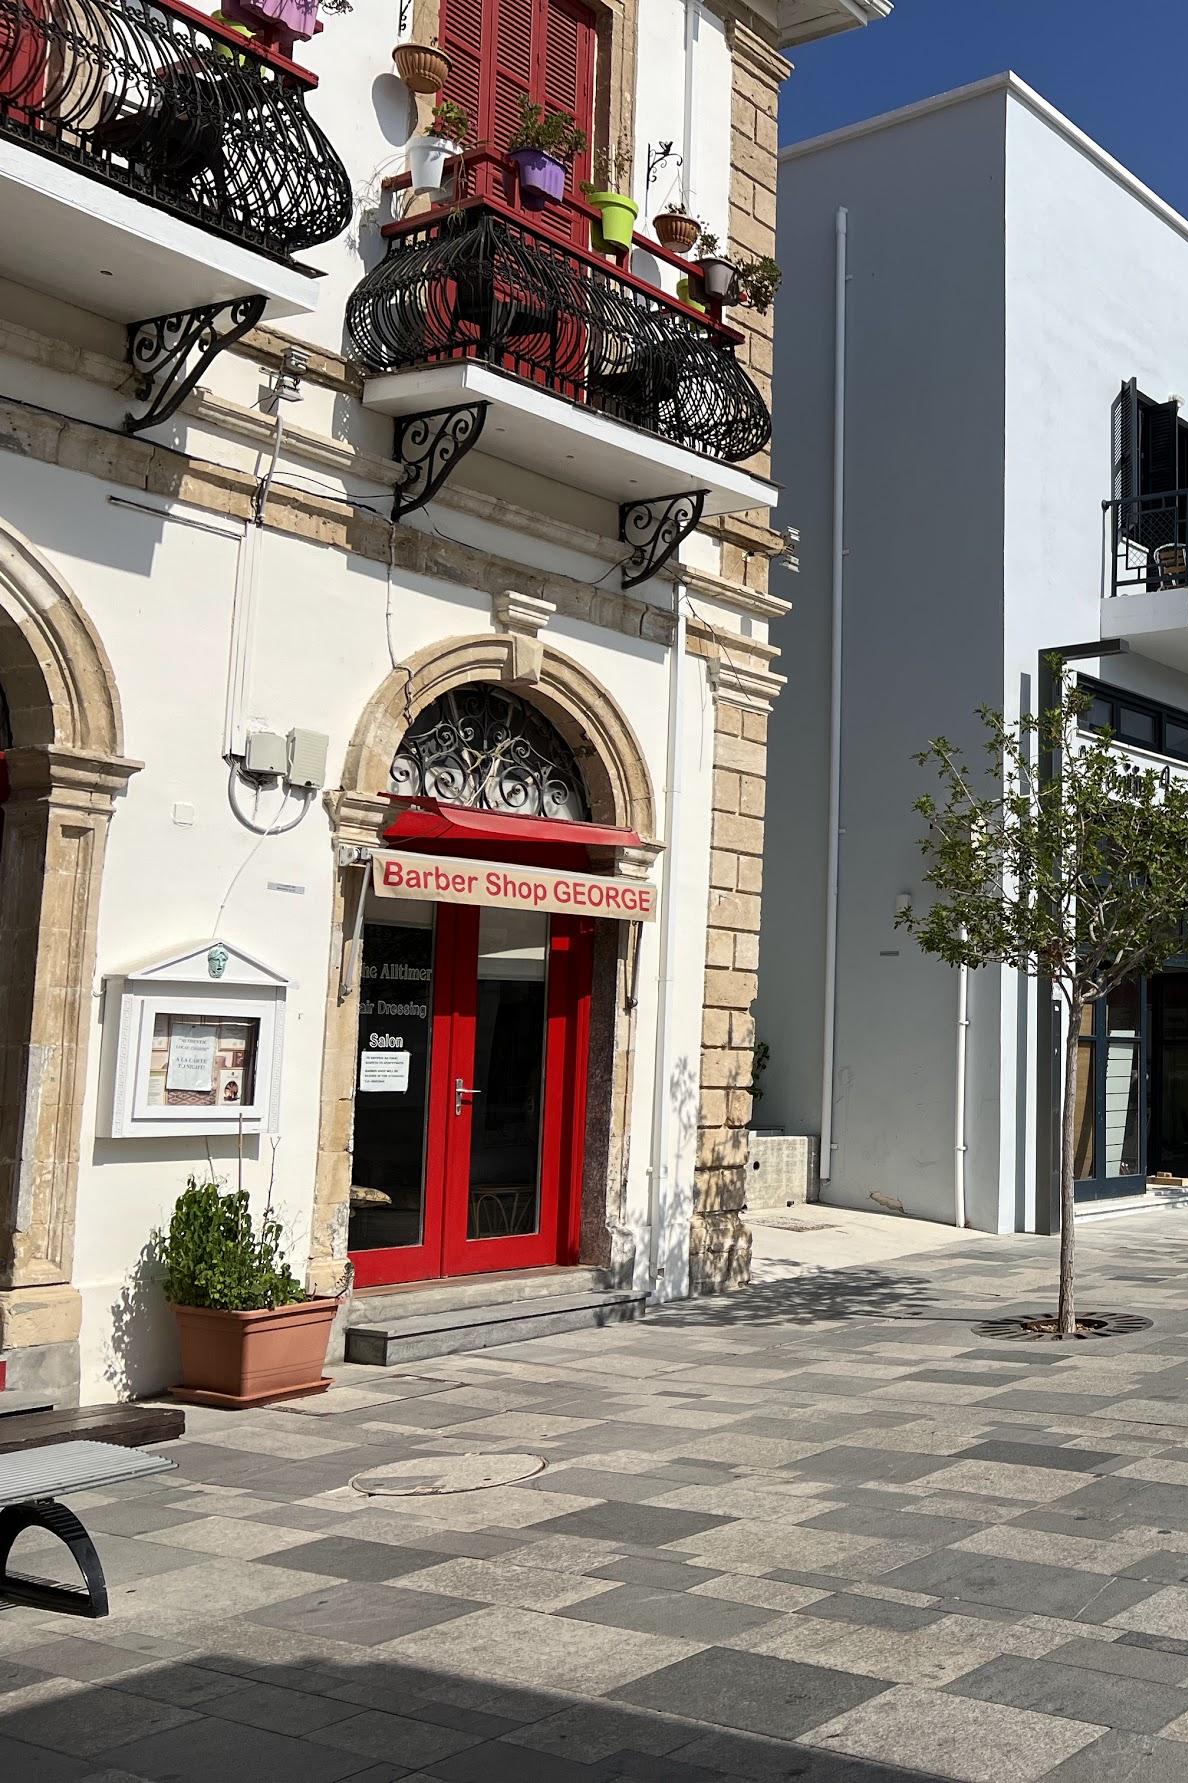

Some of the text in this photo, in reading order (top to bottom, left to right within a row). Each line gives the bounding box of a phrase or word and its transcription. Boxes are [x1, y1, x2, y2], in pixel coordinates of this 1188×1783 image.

[382, 861, 651, 912] Barber Shop GEORGE
[362, 962, 432, 981] he Alltimer
[359, 1000, 427, 1019] air Dressing
[369, 1032, 404, 1048] Salon
